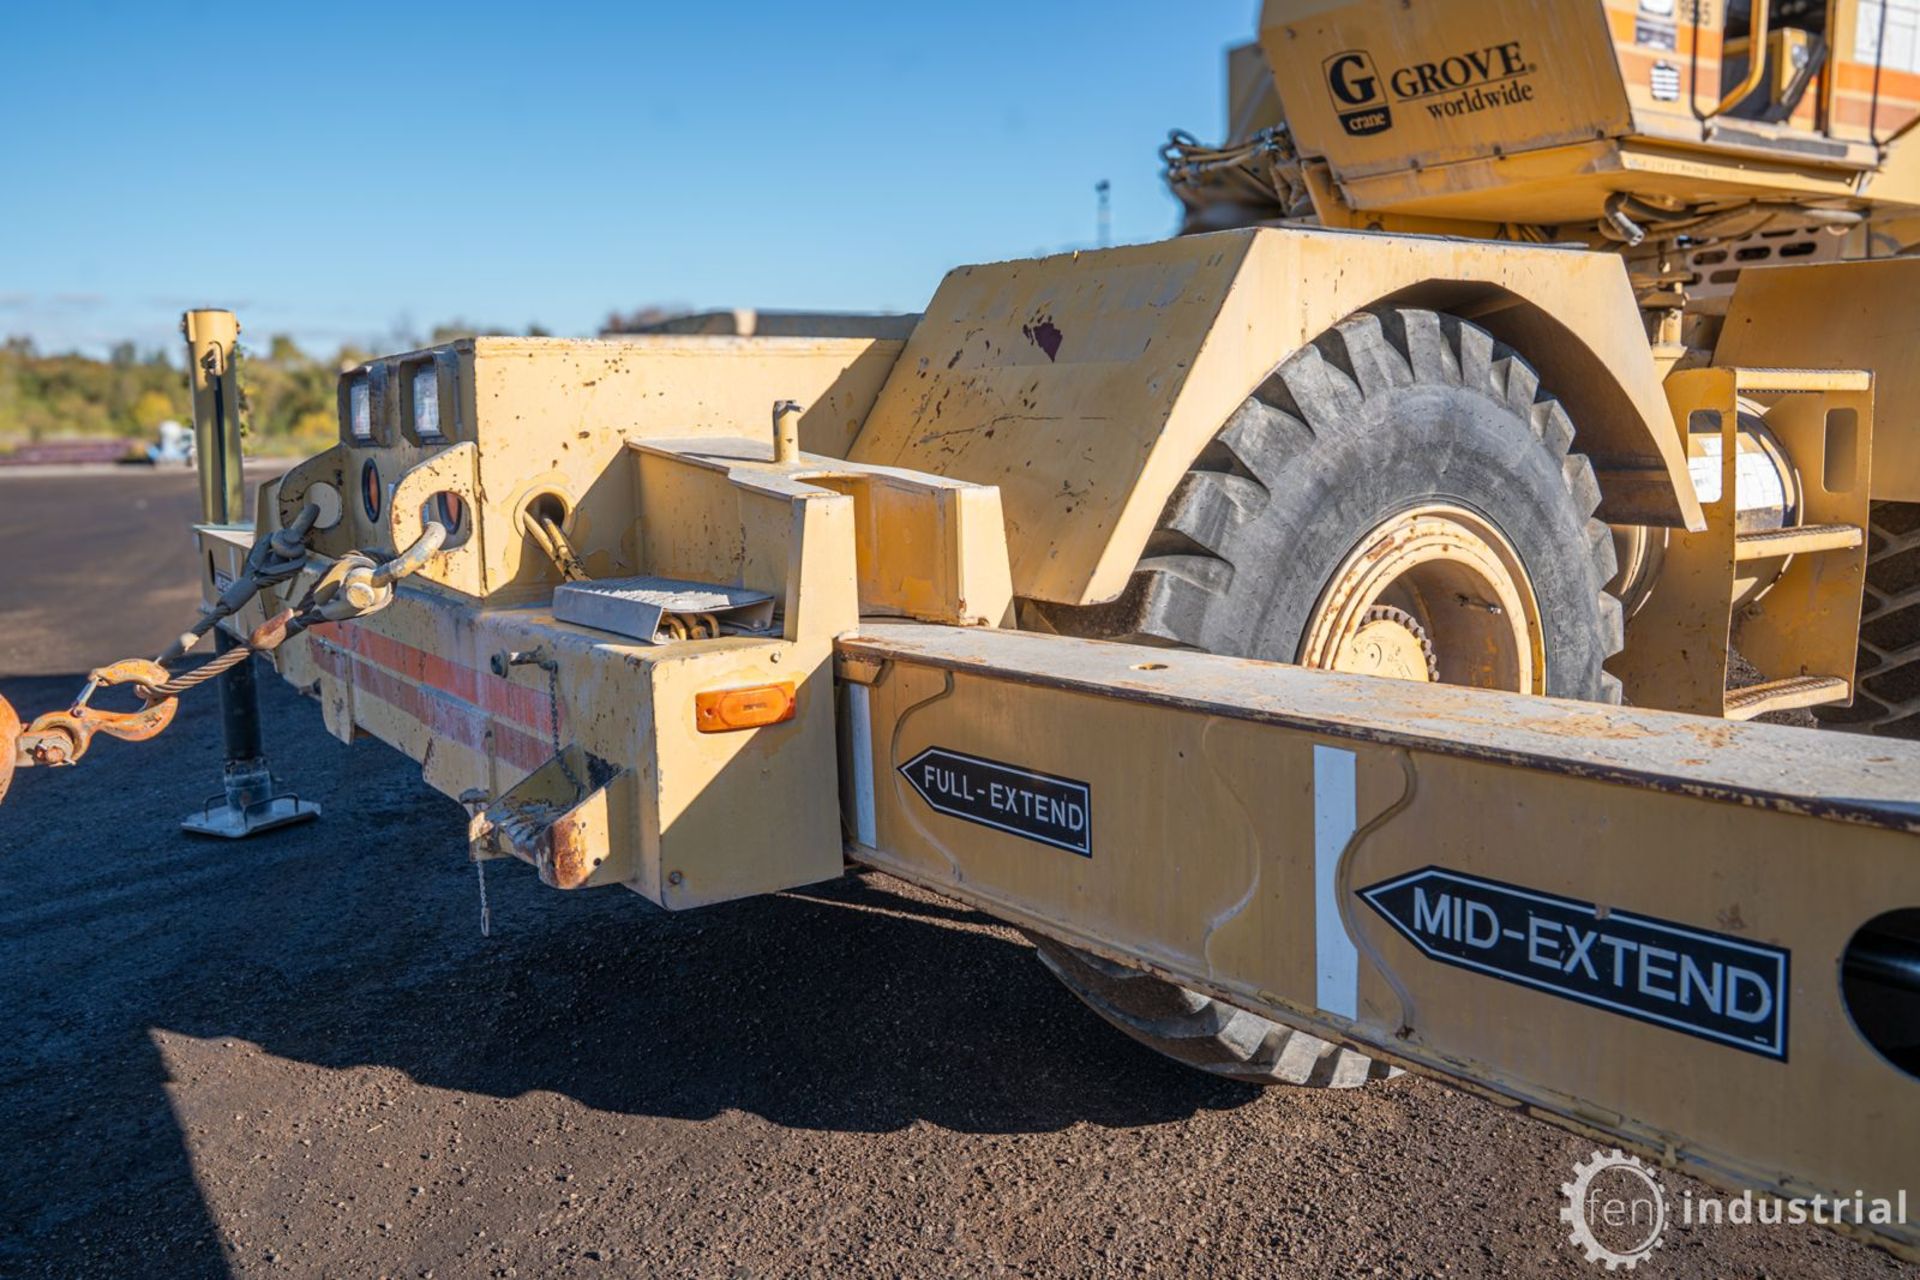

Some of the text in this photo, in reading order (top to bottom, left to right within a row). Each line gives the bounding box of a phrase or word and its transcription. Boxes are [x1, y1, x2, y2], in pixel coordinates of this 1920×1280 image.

[1330, 55, 1377, 104] G
[1391, 41, 1527, 98] GROVE
[1349, 113, 1386, 131] crane
[1426, 80, 1533, 119] worldwide
[924, 765, 1084, 831] FULL-EXTEND
[1413, 887, 1773, 1024] MID-EXTEND
